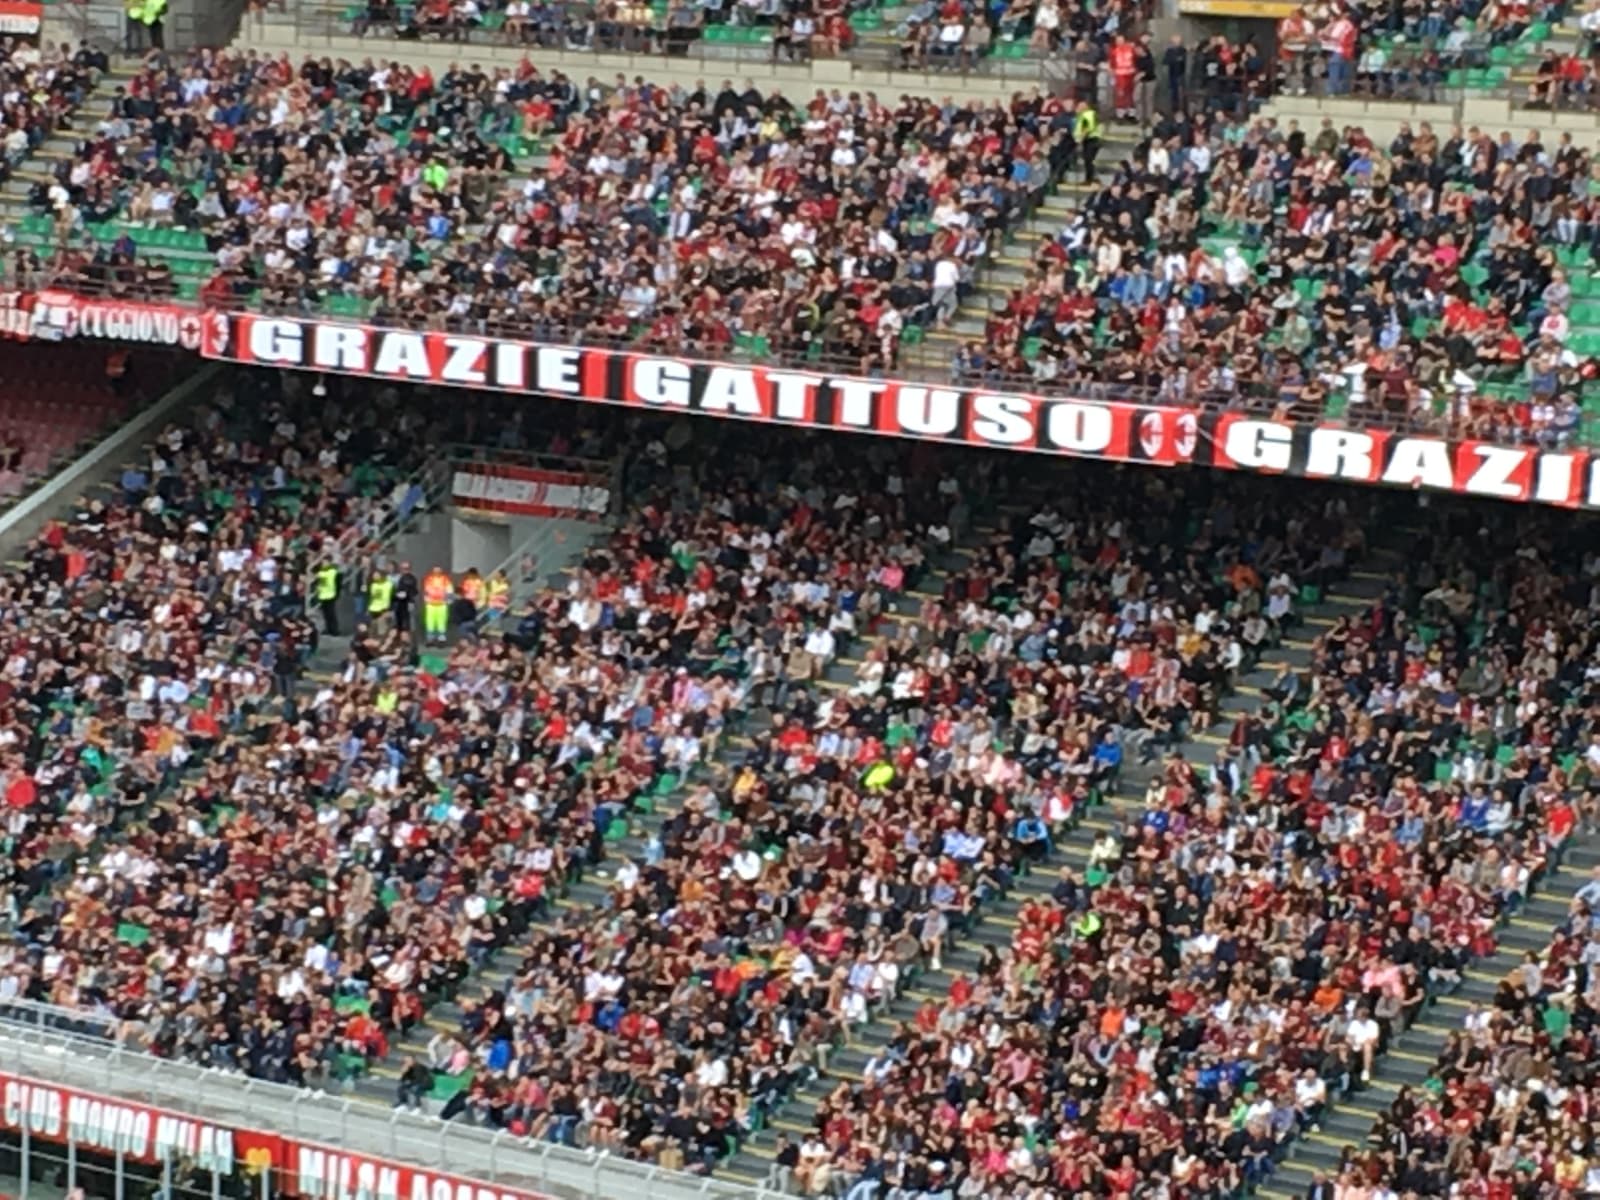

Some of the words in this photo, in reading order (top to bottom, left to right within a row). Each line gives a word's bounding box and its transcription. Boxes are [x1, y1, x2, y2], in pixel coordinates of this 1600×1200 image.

[250, 319, 581, 394] GRAZIE
[632, 359, 1113, 452] GATTUSO
[1225, 420, 1600, 505] GRAZI
[4, 1081, 62, 1136] CLUB
[67, 1095, 150, 1158] MONDO
[154, 1115, 233, 1176] MILAN
[299, 1147, 399, 1200] MILAN
